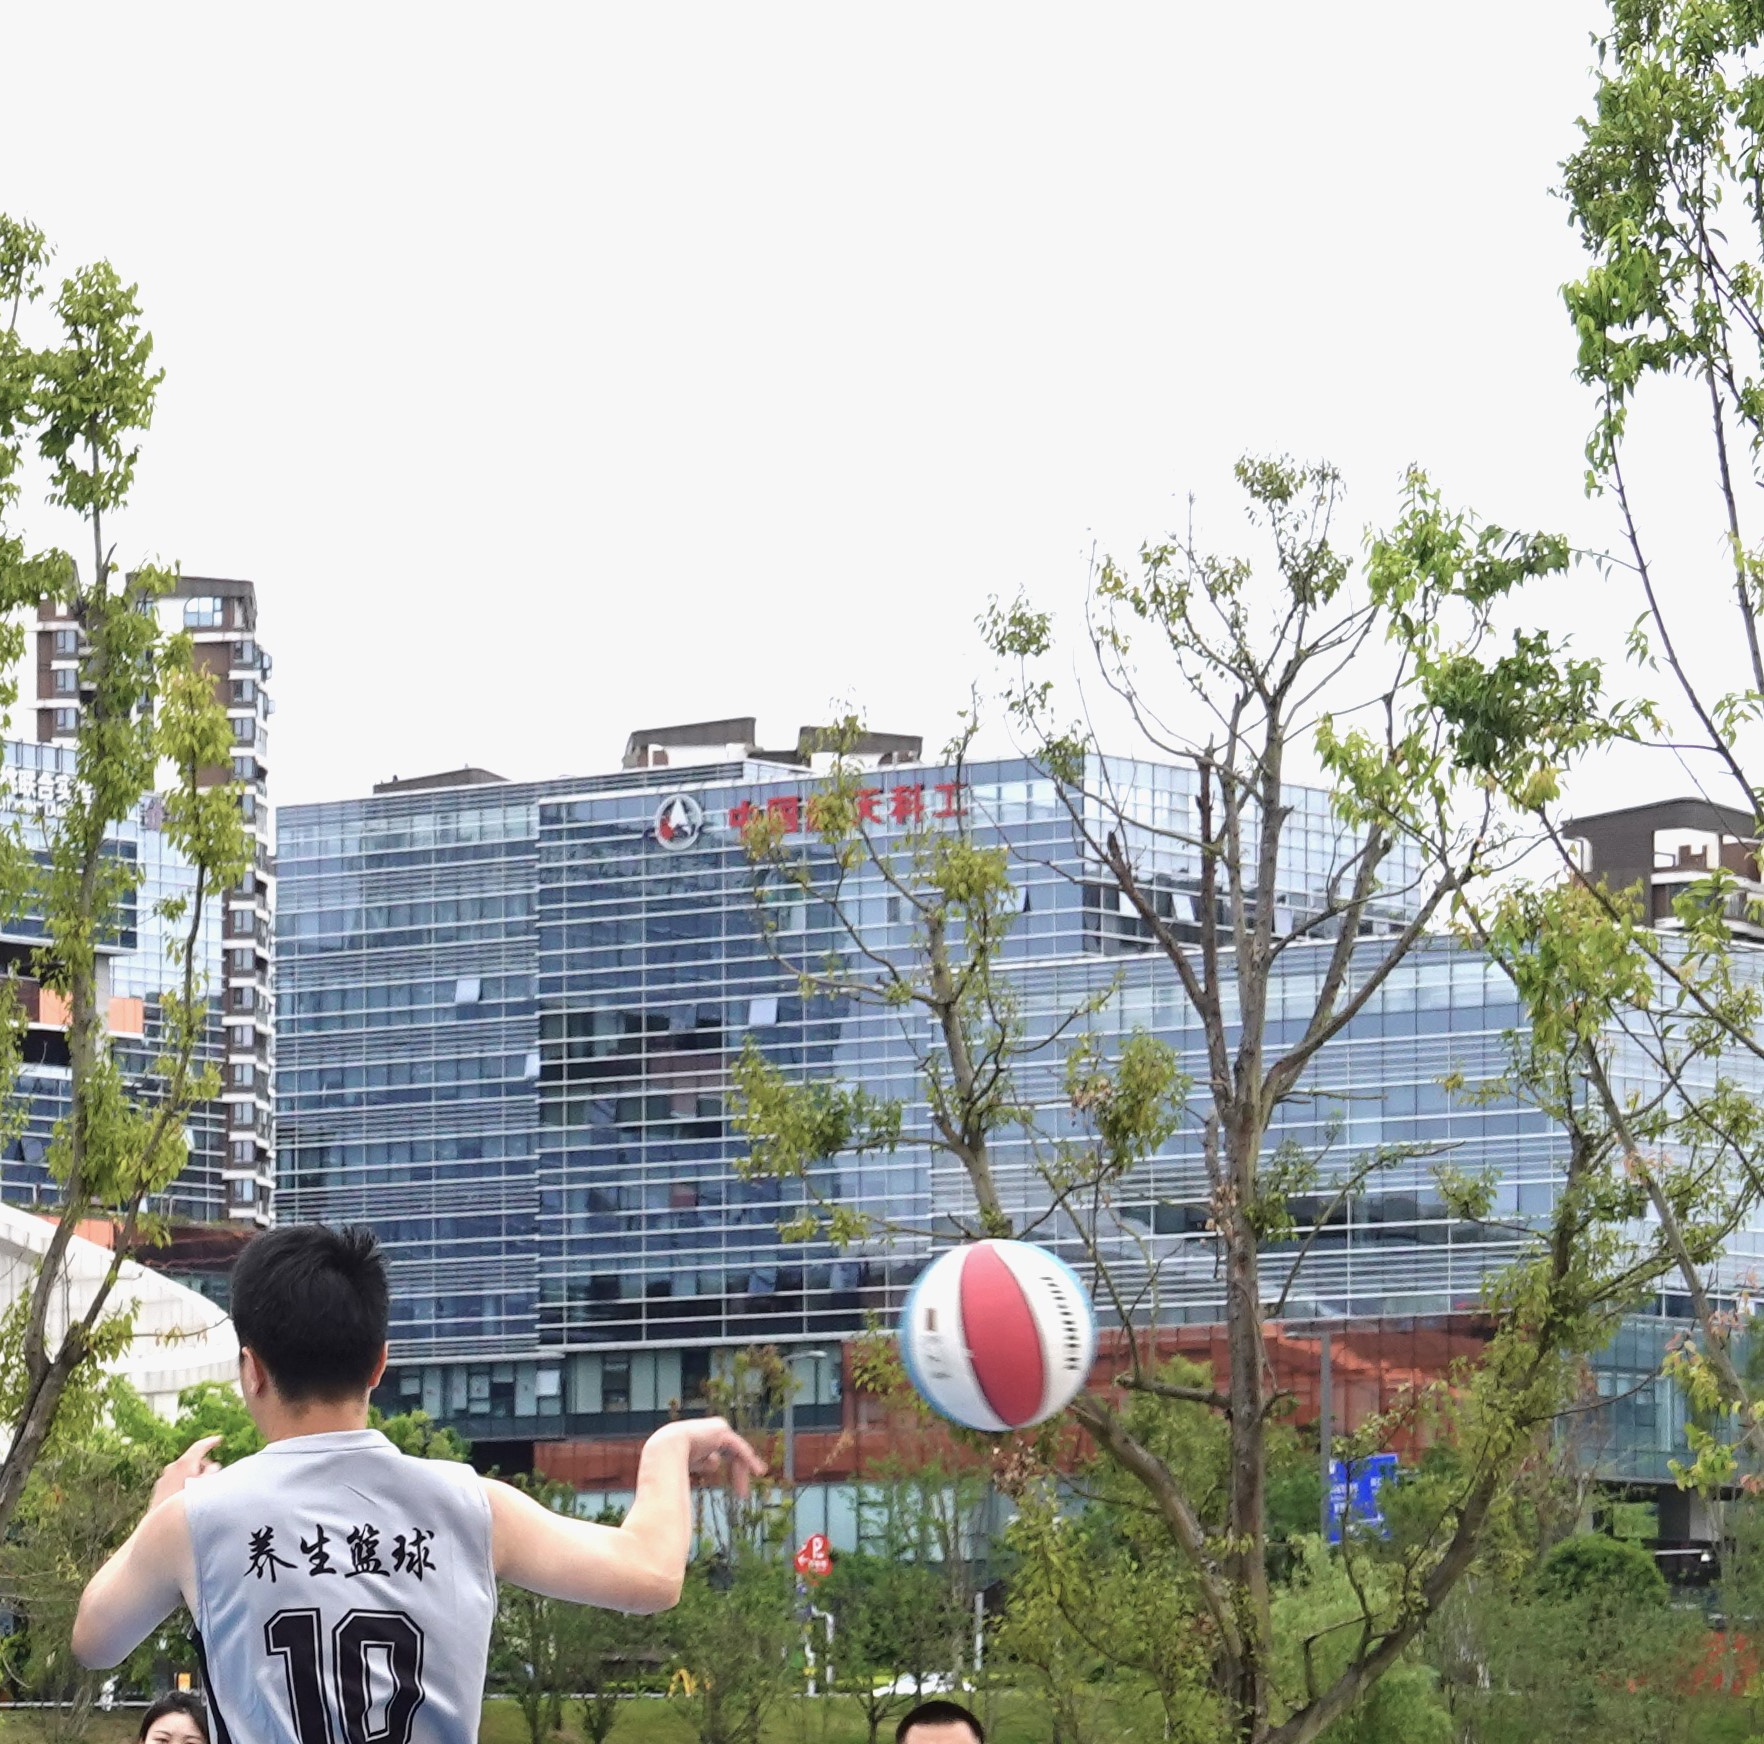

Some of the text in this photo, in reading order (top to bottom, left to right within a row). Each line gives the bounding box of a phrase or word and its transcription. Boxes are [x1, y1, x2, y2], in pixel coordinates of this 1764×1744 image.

[728, 782, 969, 838] 中国天科工
[243, 1523, 437, 1583] 养生篮球
